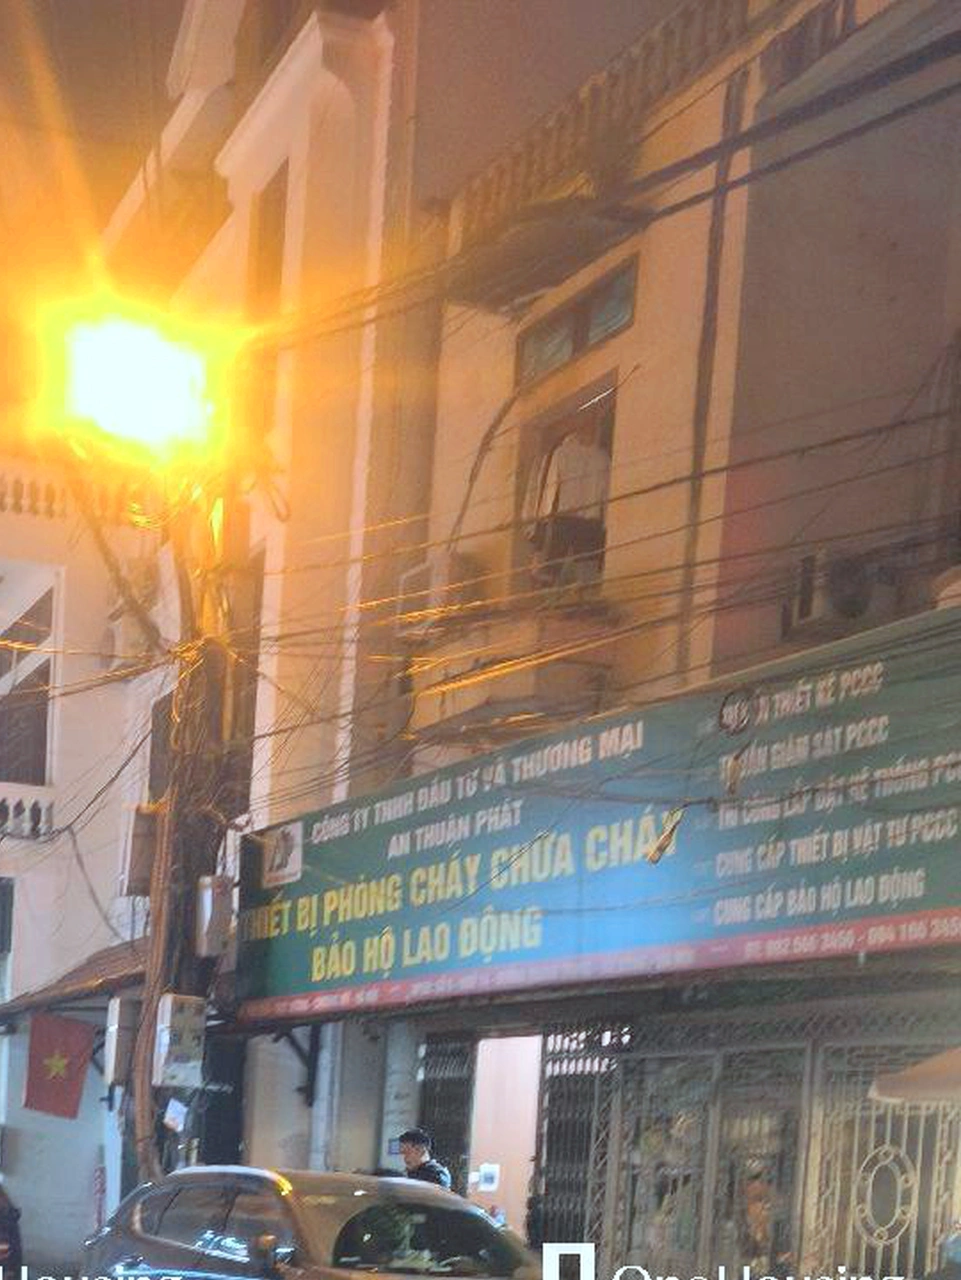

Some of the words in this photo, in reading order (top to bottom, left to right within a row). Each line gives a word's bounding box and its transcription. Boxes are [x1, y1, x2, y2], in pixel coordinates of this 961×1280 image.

[844, 714, 890, 753] PCCC
[311, 812, 350, 844] CÔNG
[353, 805, 371, 833] TY
[374, 790, 414, 826] TNHH
[417, 776, 452, 811] ĐẦU
[511, 735, 593, 784] THƯƠNG
[597, 719, 645, 761] MẠI
[387, 830, 411, 861] AN
[414, 812, 471, 854] THUẬN
[473, 798, 524, 837] PHÁT
[715, 847, 753, 879] CUNG
[756, 832, 786, 873] CẤP
[789, 824, 830, 868] THIẾT
[832, 829, 849, 863] BỊ
[296, 893, 319, 938] BỊ
[323, 873, 403, 927] PHÒNG
[410, 848, 482, 907] CHÁY
[713, 895, 752, 926] CUNG
[754, 881, 785, 920] CẤP
[788, 875, 818, 917] BẢO
[844, 873, 877, 909] LAO
[879, 866, 927, 909] ĐỘNG
[311, 931, 356, 984] BẢO
[361, 924, 396, 979] HỘ
[401, 920, 451, 969] LAO
[458, 903, 544, 964] ĐỘNG
